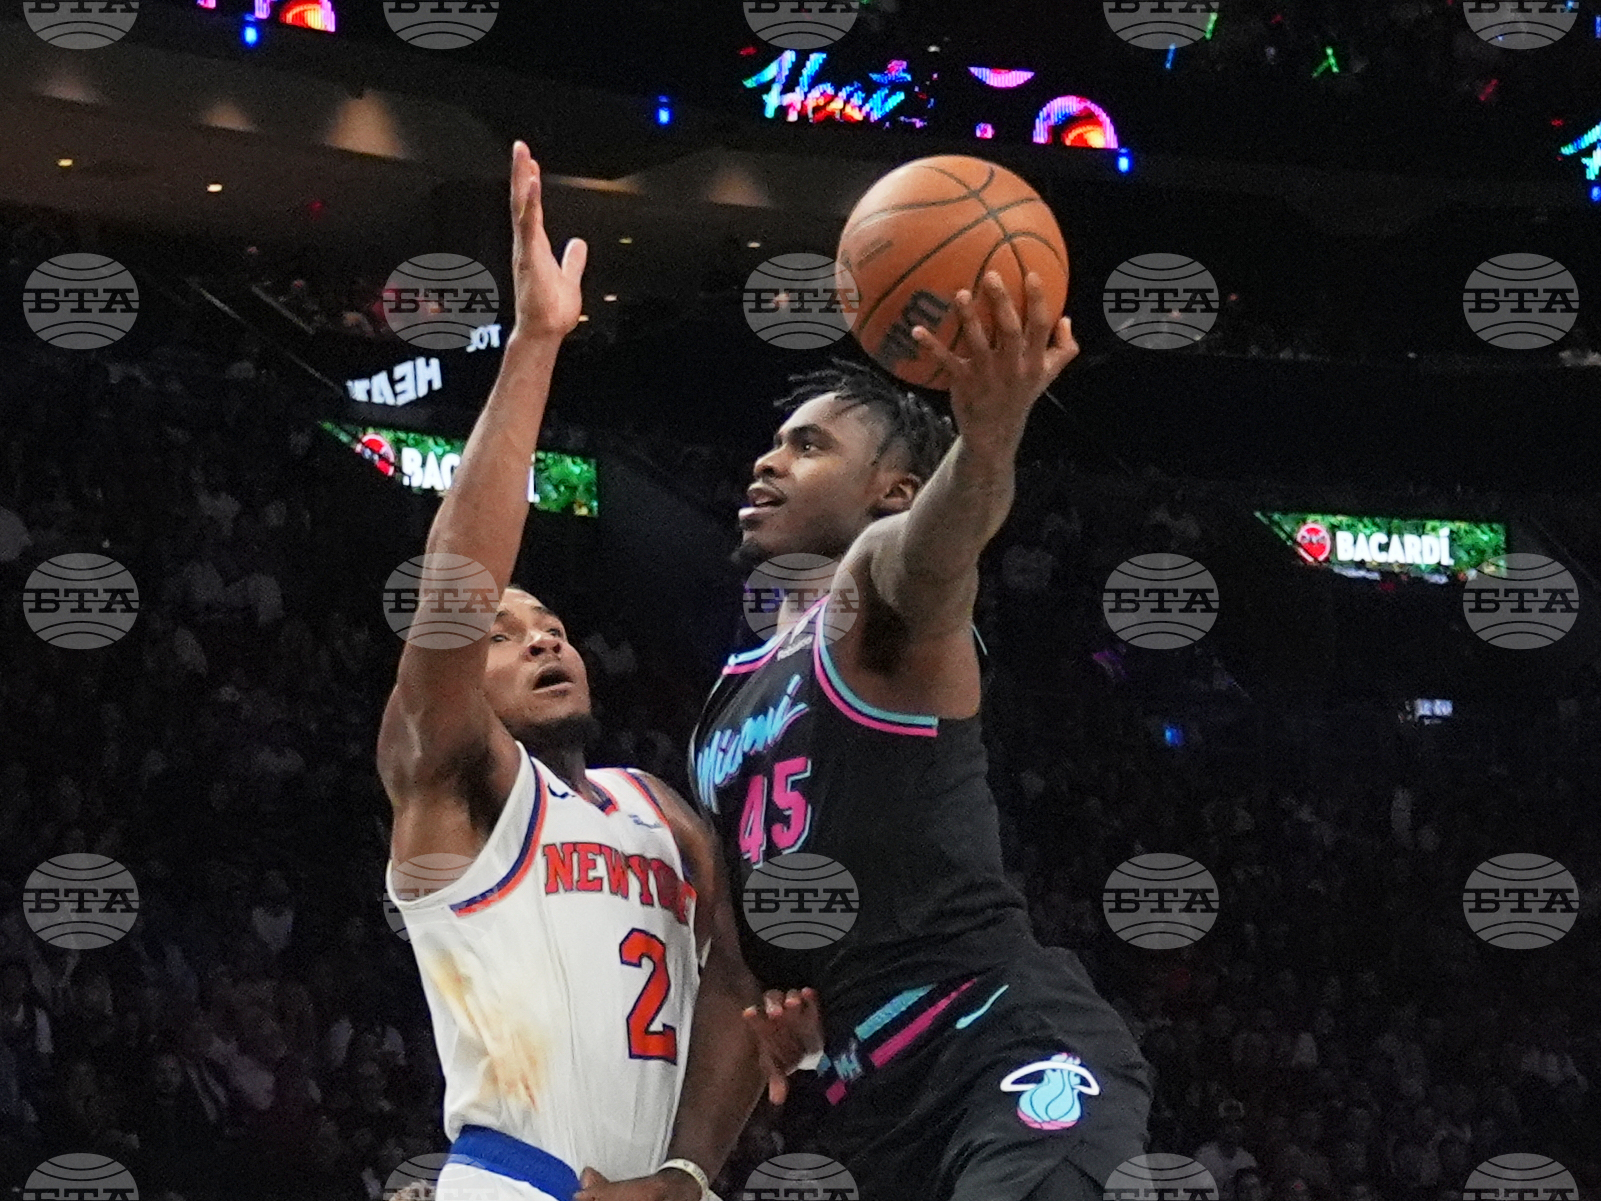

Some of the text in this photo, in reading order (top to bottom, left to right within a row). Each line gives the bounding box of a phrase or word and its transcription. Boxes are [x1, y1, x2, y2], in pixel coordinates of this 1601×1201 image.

[1336, 527, 1455, 566] BACARDÍ
[697, 674, 809, 815] Miami
[739, 756, 812, 869] 45
[543, 842, 629, 900] NEW
[619, 927, 678, 1065] 2
